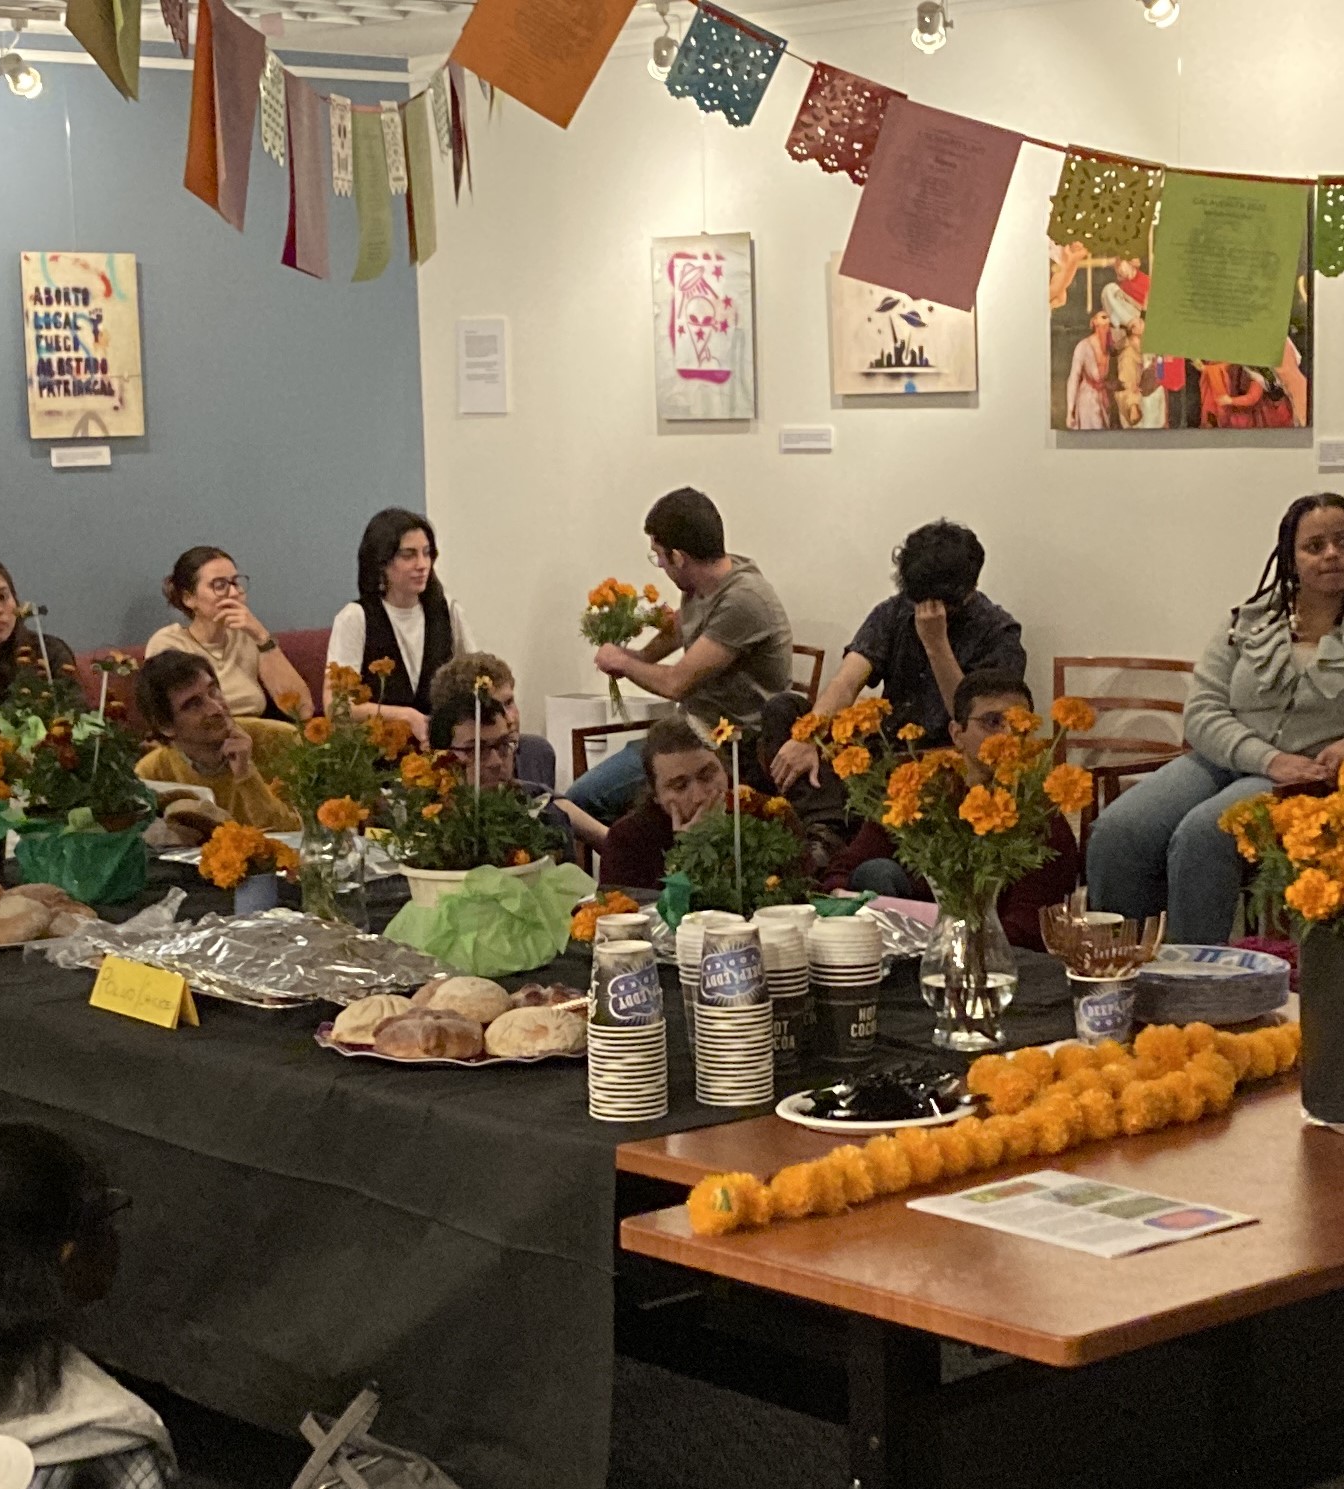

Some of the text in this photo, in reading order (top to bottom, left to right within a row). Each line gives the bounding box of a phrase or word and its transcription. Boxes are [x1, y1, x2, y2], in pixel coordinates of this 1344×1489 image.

[706, 970, 732, 989] EDDY
[772, 1020, 789, 1036] OT
[850, 1019, 878, 1038] COC
